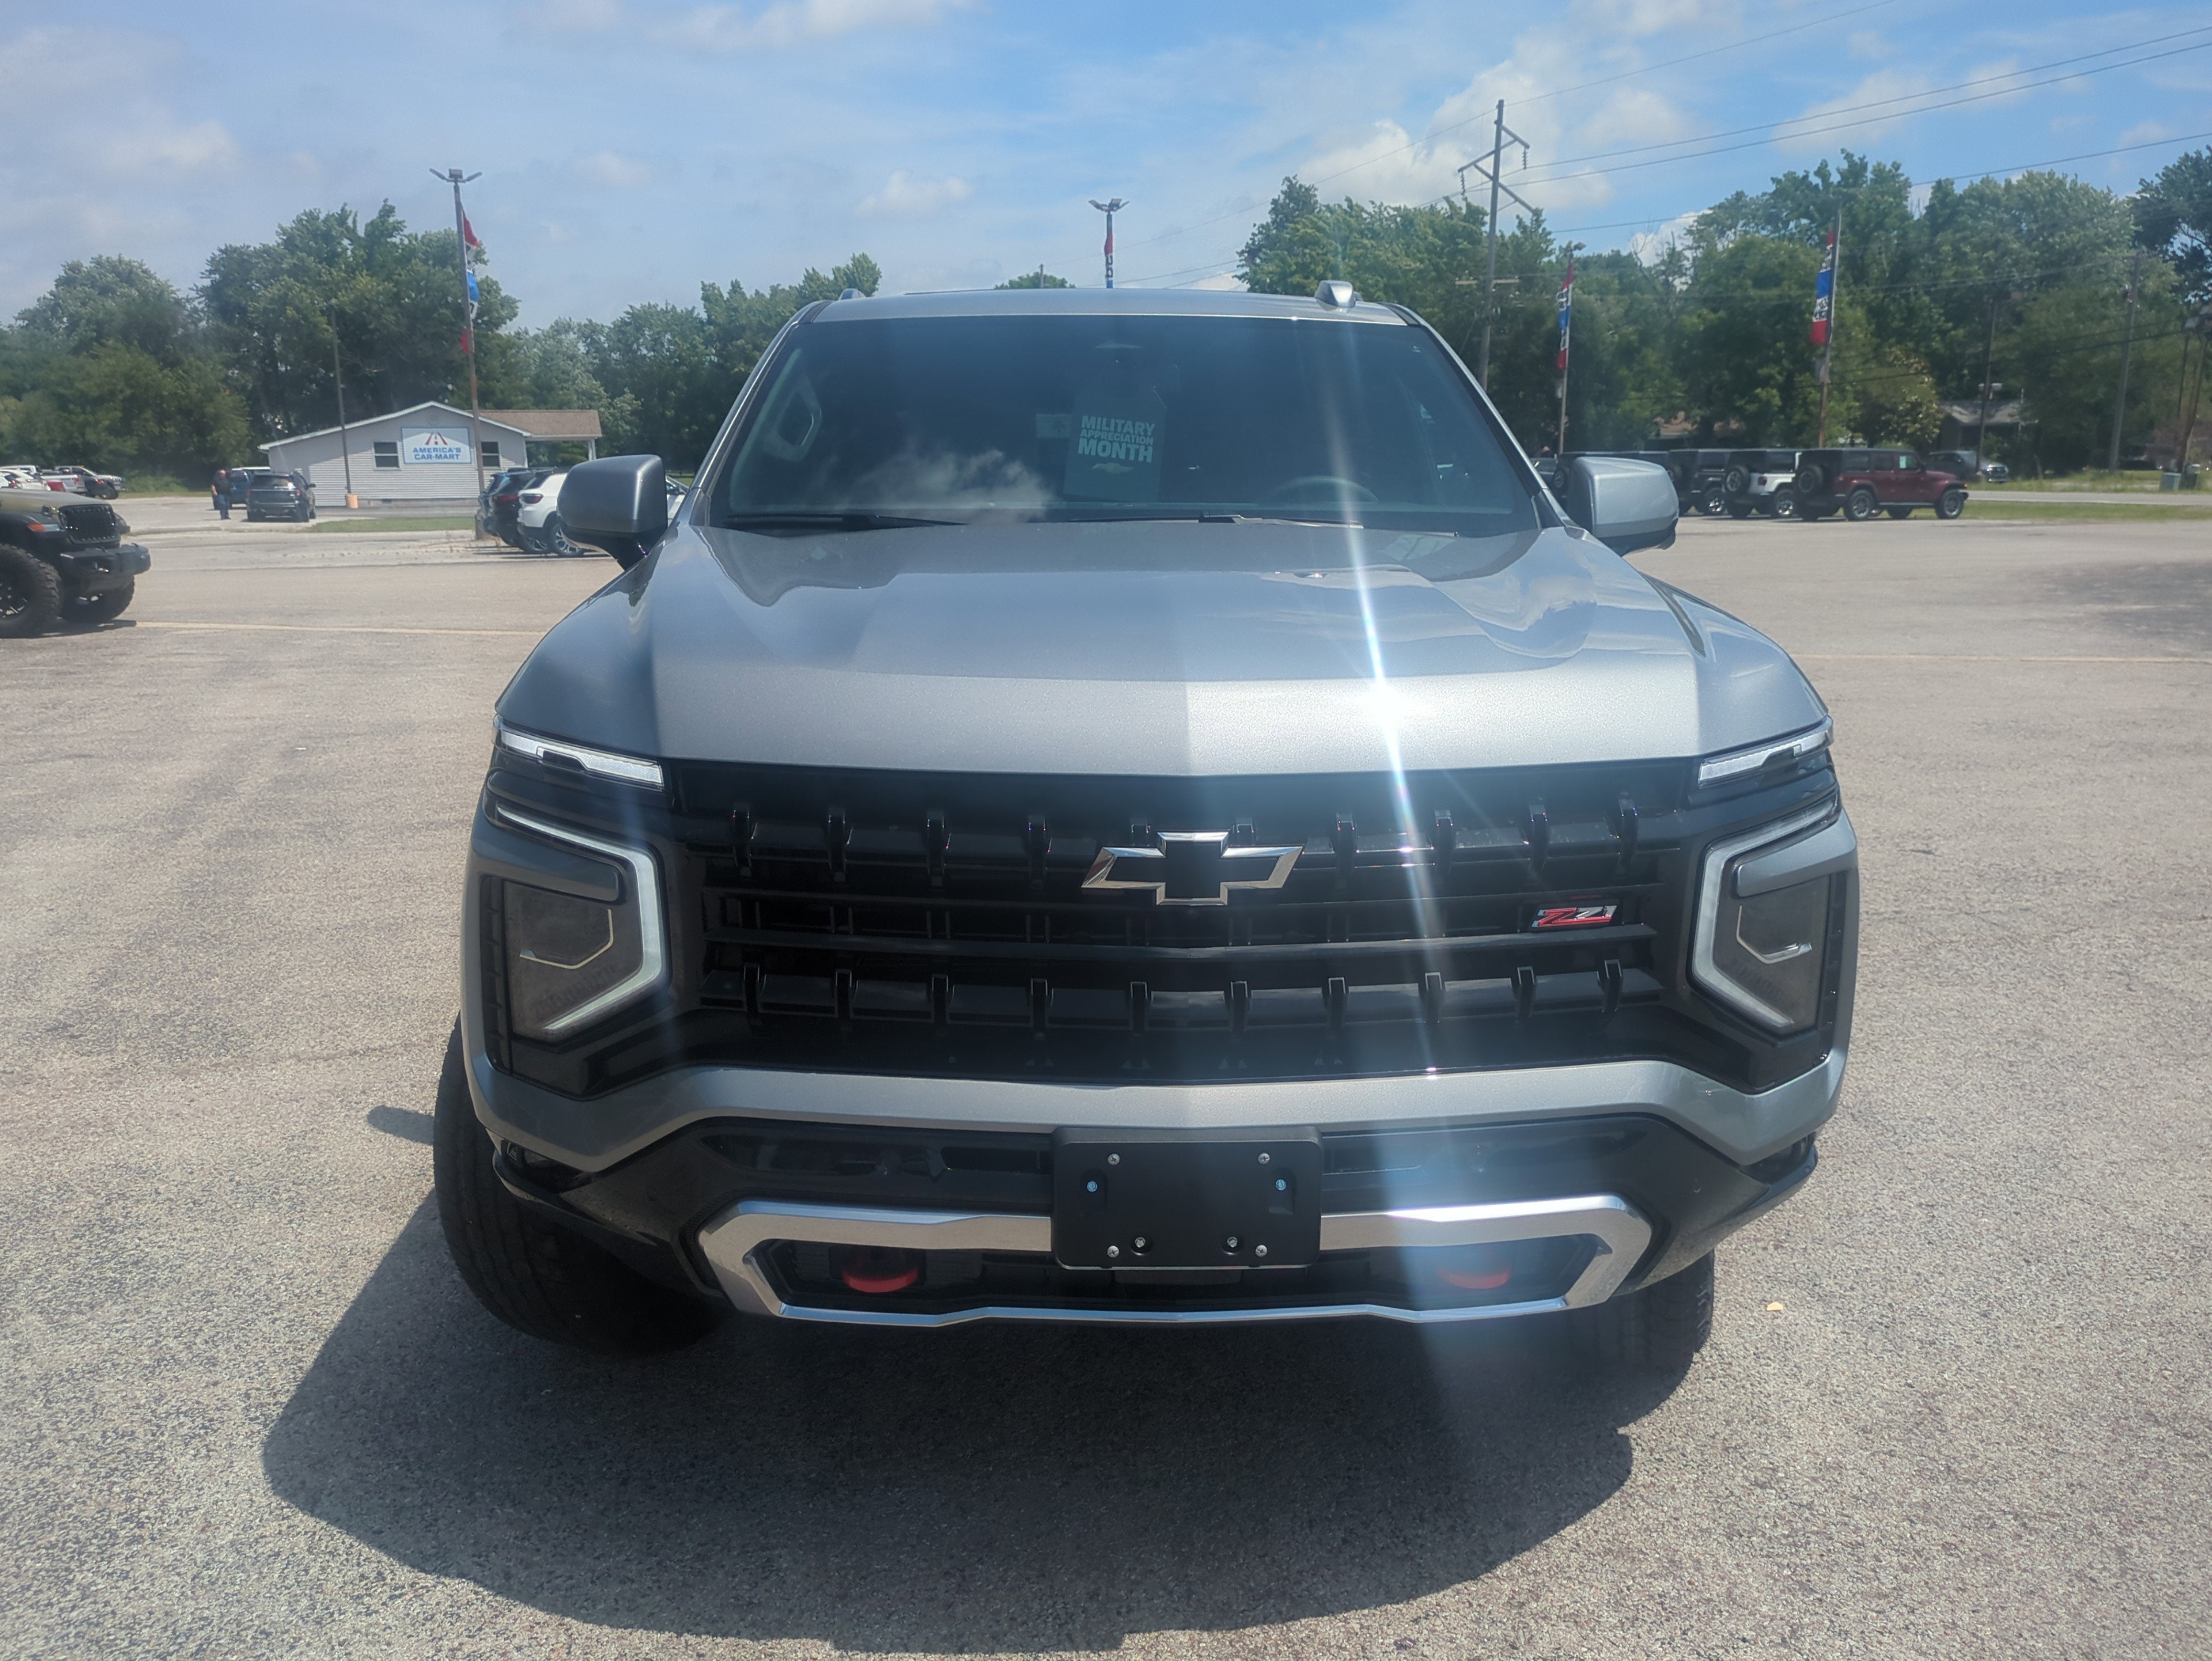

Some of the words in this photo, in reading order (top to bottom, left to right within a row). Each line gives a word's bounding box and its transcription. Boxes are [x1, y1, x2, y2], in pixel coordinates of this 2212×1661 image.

[1082, 415, 1155, 436] MILITARY
[1081, 429, 1153, 445] APPRECIATION
[1078, 438, 1153, 463] MONTH
[1531, 905, 1617, 928] Z71
